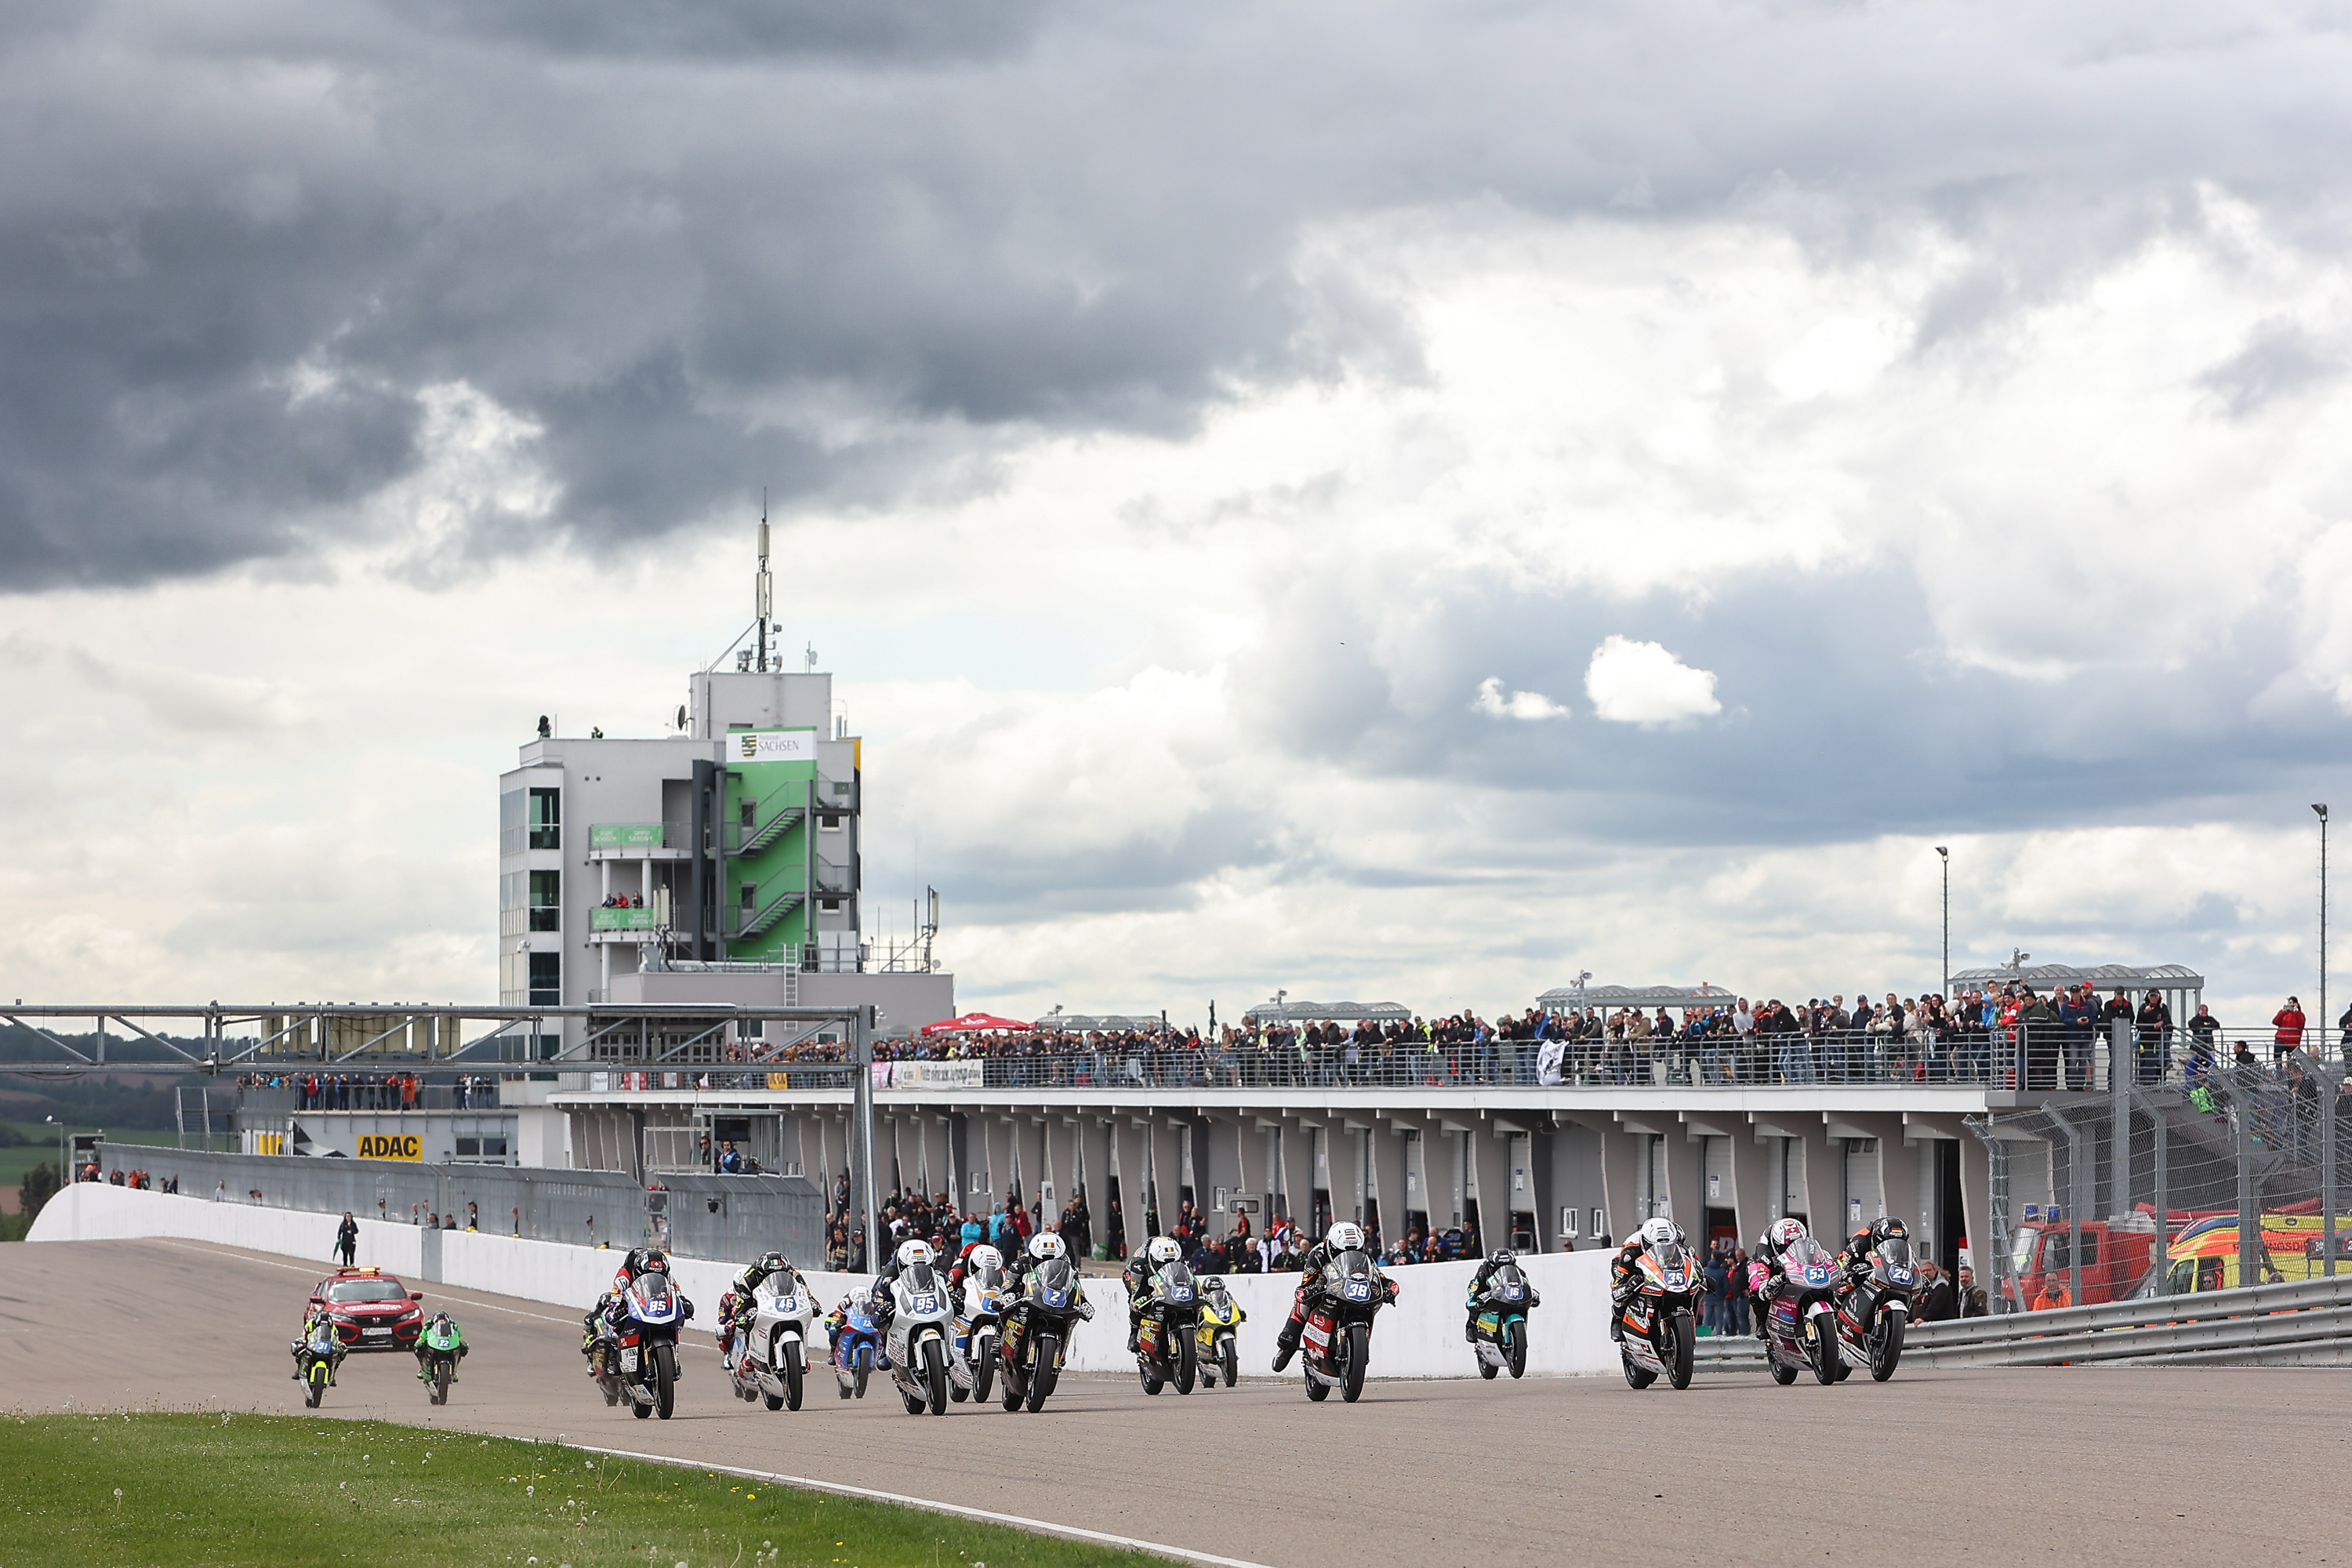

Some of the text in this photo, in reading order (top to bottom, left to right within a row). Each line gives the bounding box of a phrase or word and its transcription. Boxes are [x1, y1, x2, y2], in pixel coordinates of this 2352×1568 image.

[758, 740, 799, 751] SACHSEN
[359, 1137, 418, 1156] ADAC
[1668, 1272, 1683, 1284] 36
[1809, 1268, 1824, 1280] 53
[1893, 1269, 1910, 1280] 20
[1175, 1287, 1189, 1298] 23
[1348, 1283, 1368, 1297] 38
[1509, 1287, 1519, 1297] 16
[1050, 1291, 1061, 1301] 2
[649, 1301, 666, 1312] 85
[779, 1298, 794, 1308] 46
[916, 1298, 935, 1311] 95
[318, 1341, 328, 1350] 31
